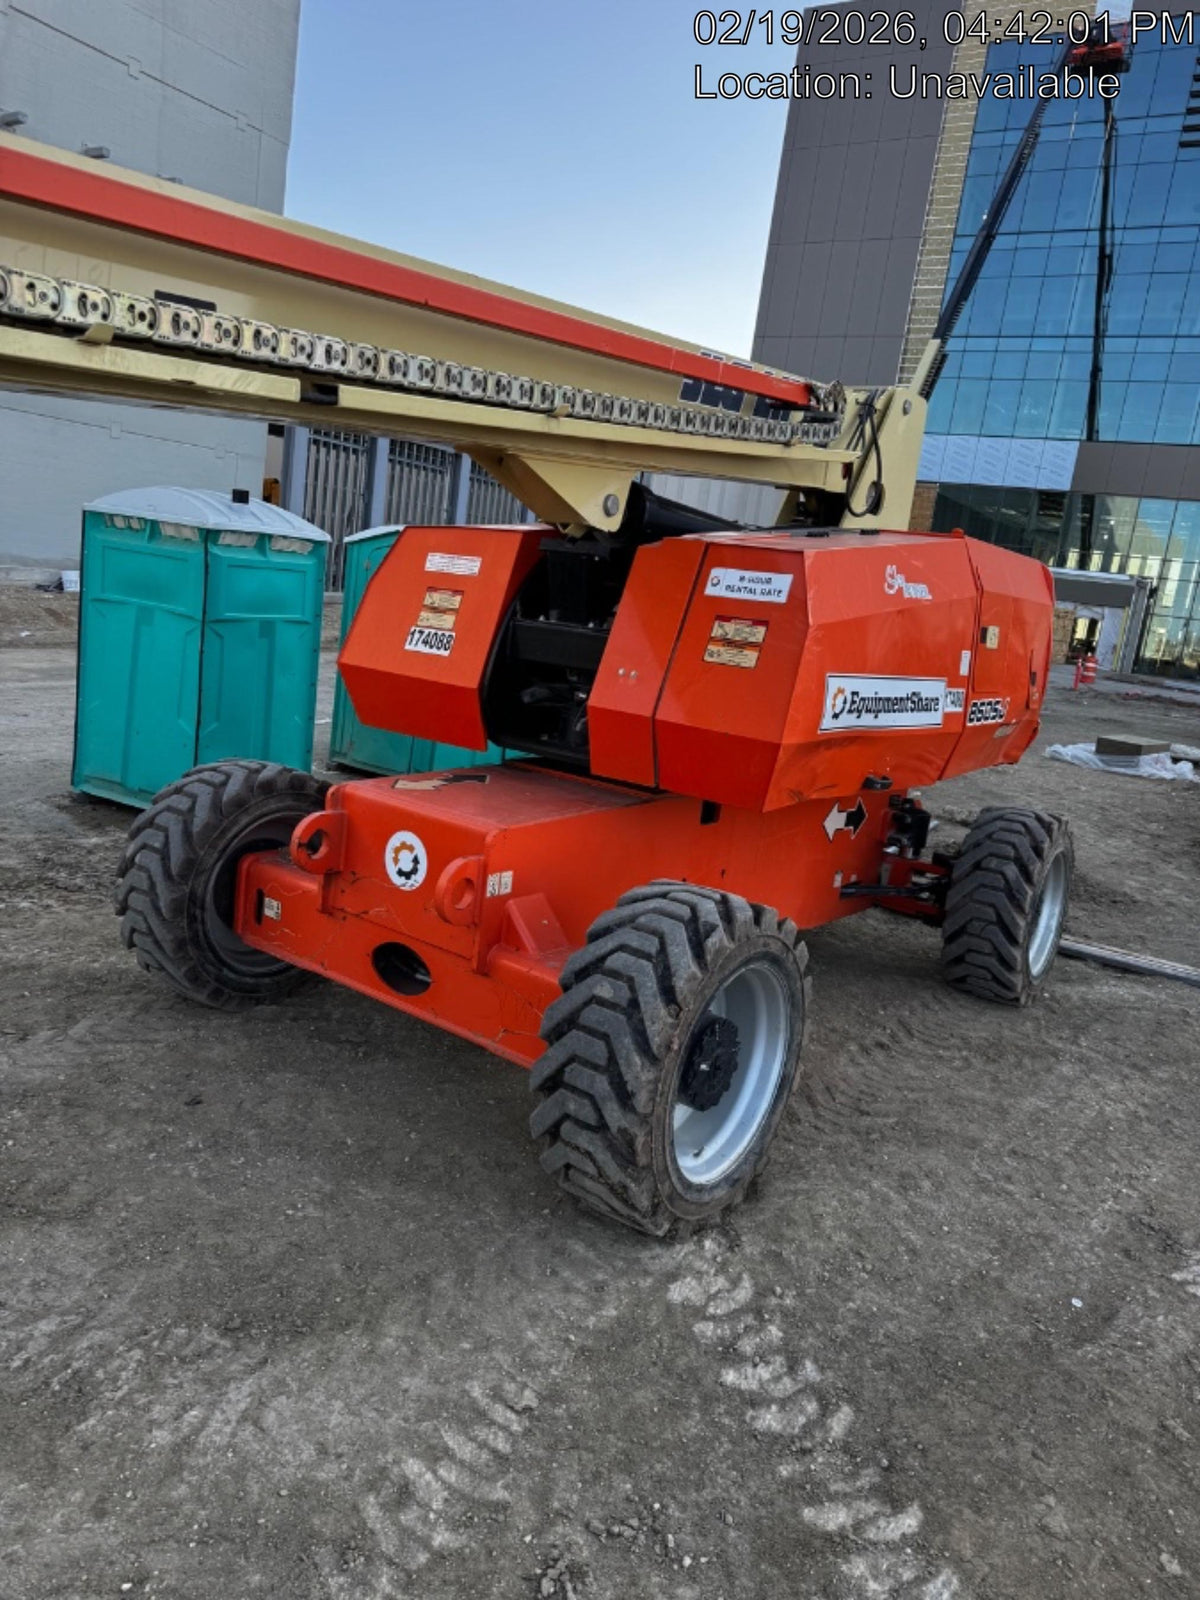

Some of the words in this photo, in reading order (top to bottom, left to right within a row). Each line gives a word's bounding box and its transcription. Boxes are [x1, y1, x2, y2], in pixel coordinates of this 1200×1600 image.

[725, 584, 757, 596] RENTAL
[759, 587, 783, 598] RATE
[408, 629, 455, 651] 174088
[847, 691, 940, 719] EquipmentShare
